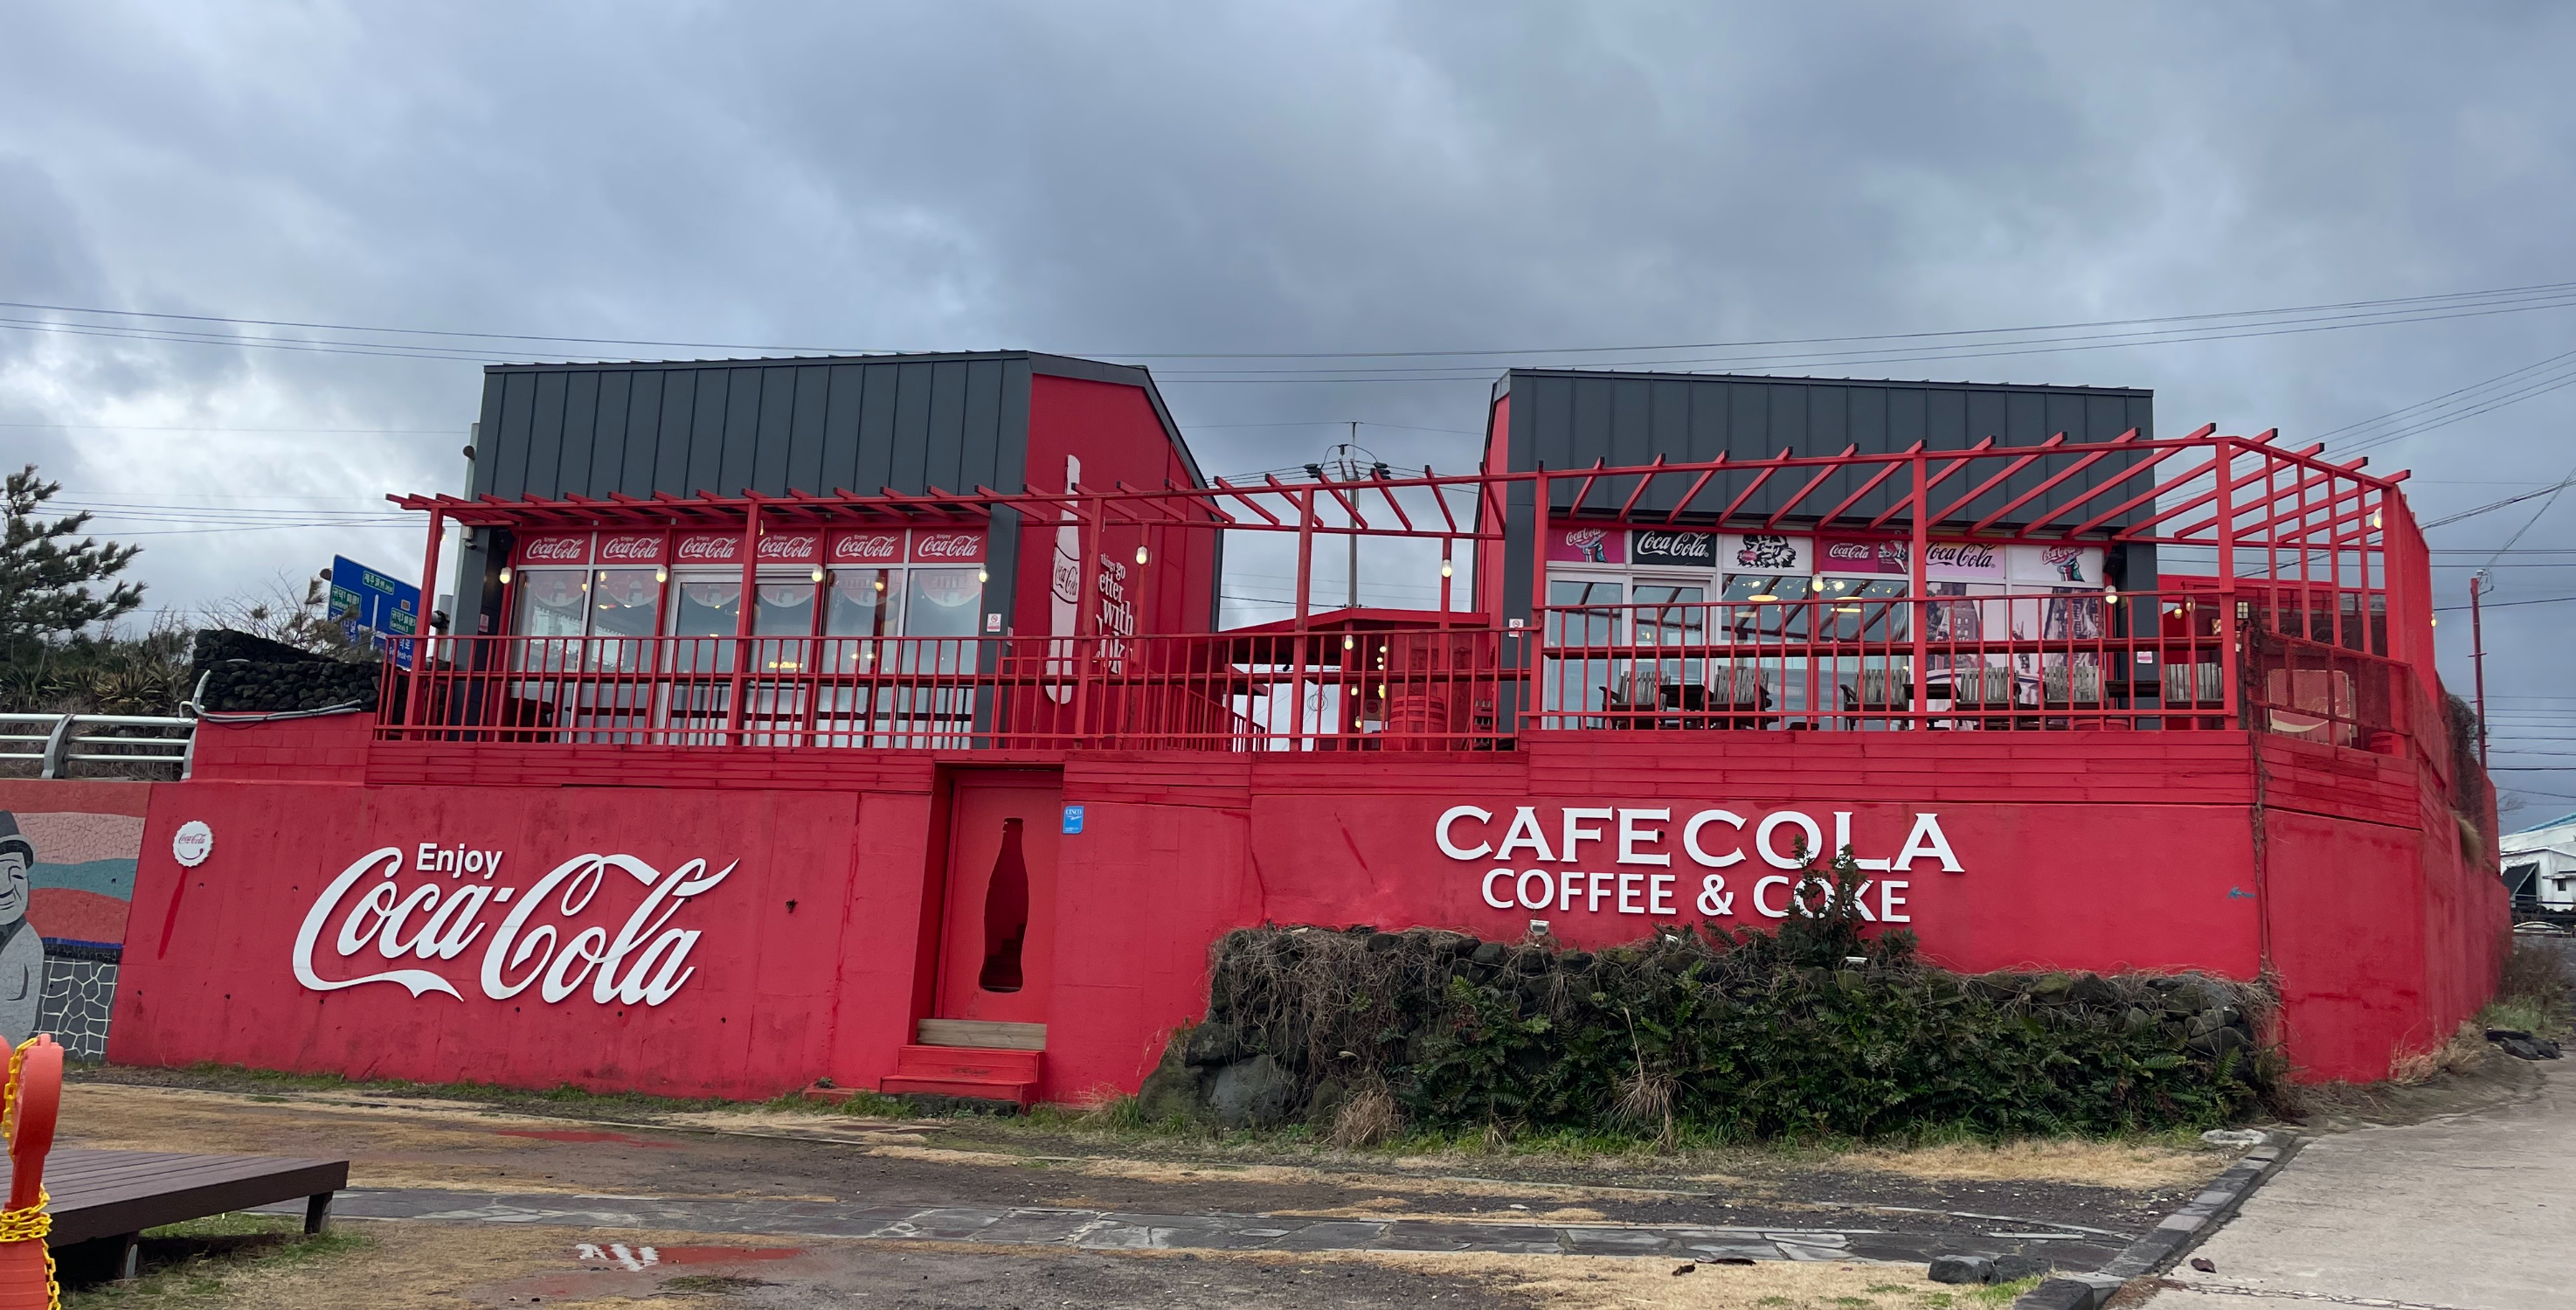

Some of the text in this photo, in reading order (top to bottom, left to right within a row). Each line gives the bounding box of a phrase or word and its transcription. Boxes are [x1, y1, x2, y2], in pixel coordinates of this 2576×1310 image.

[1098, 571, 1125, 603] etter
[1116, 562, 1126, 580] go
[1102, 599, 1133, 635] with
[416, 842, 502, 880] Enjoy
[1482, 868, 1677, 915] COFFEE
[1696, 873, 1734, 916] &
[292, 846, 740, 1007] Coca-Cola
